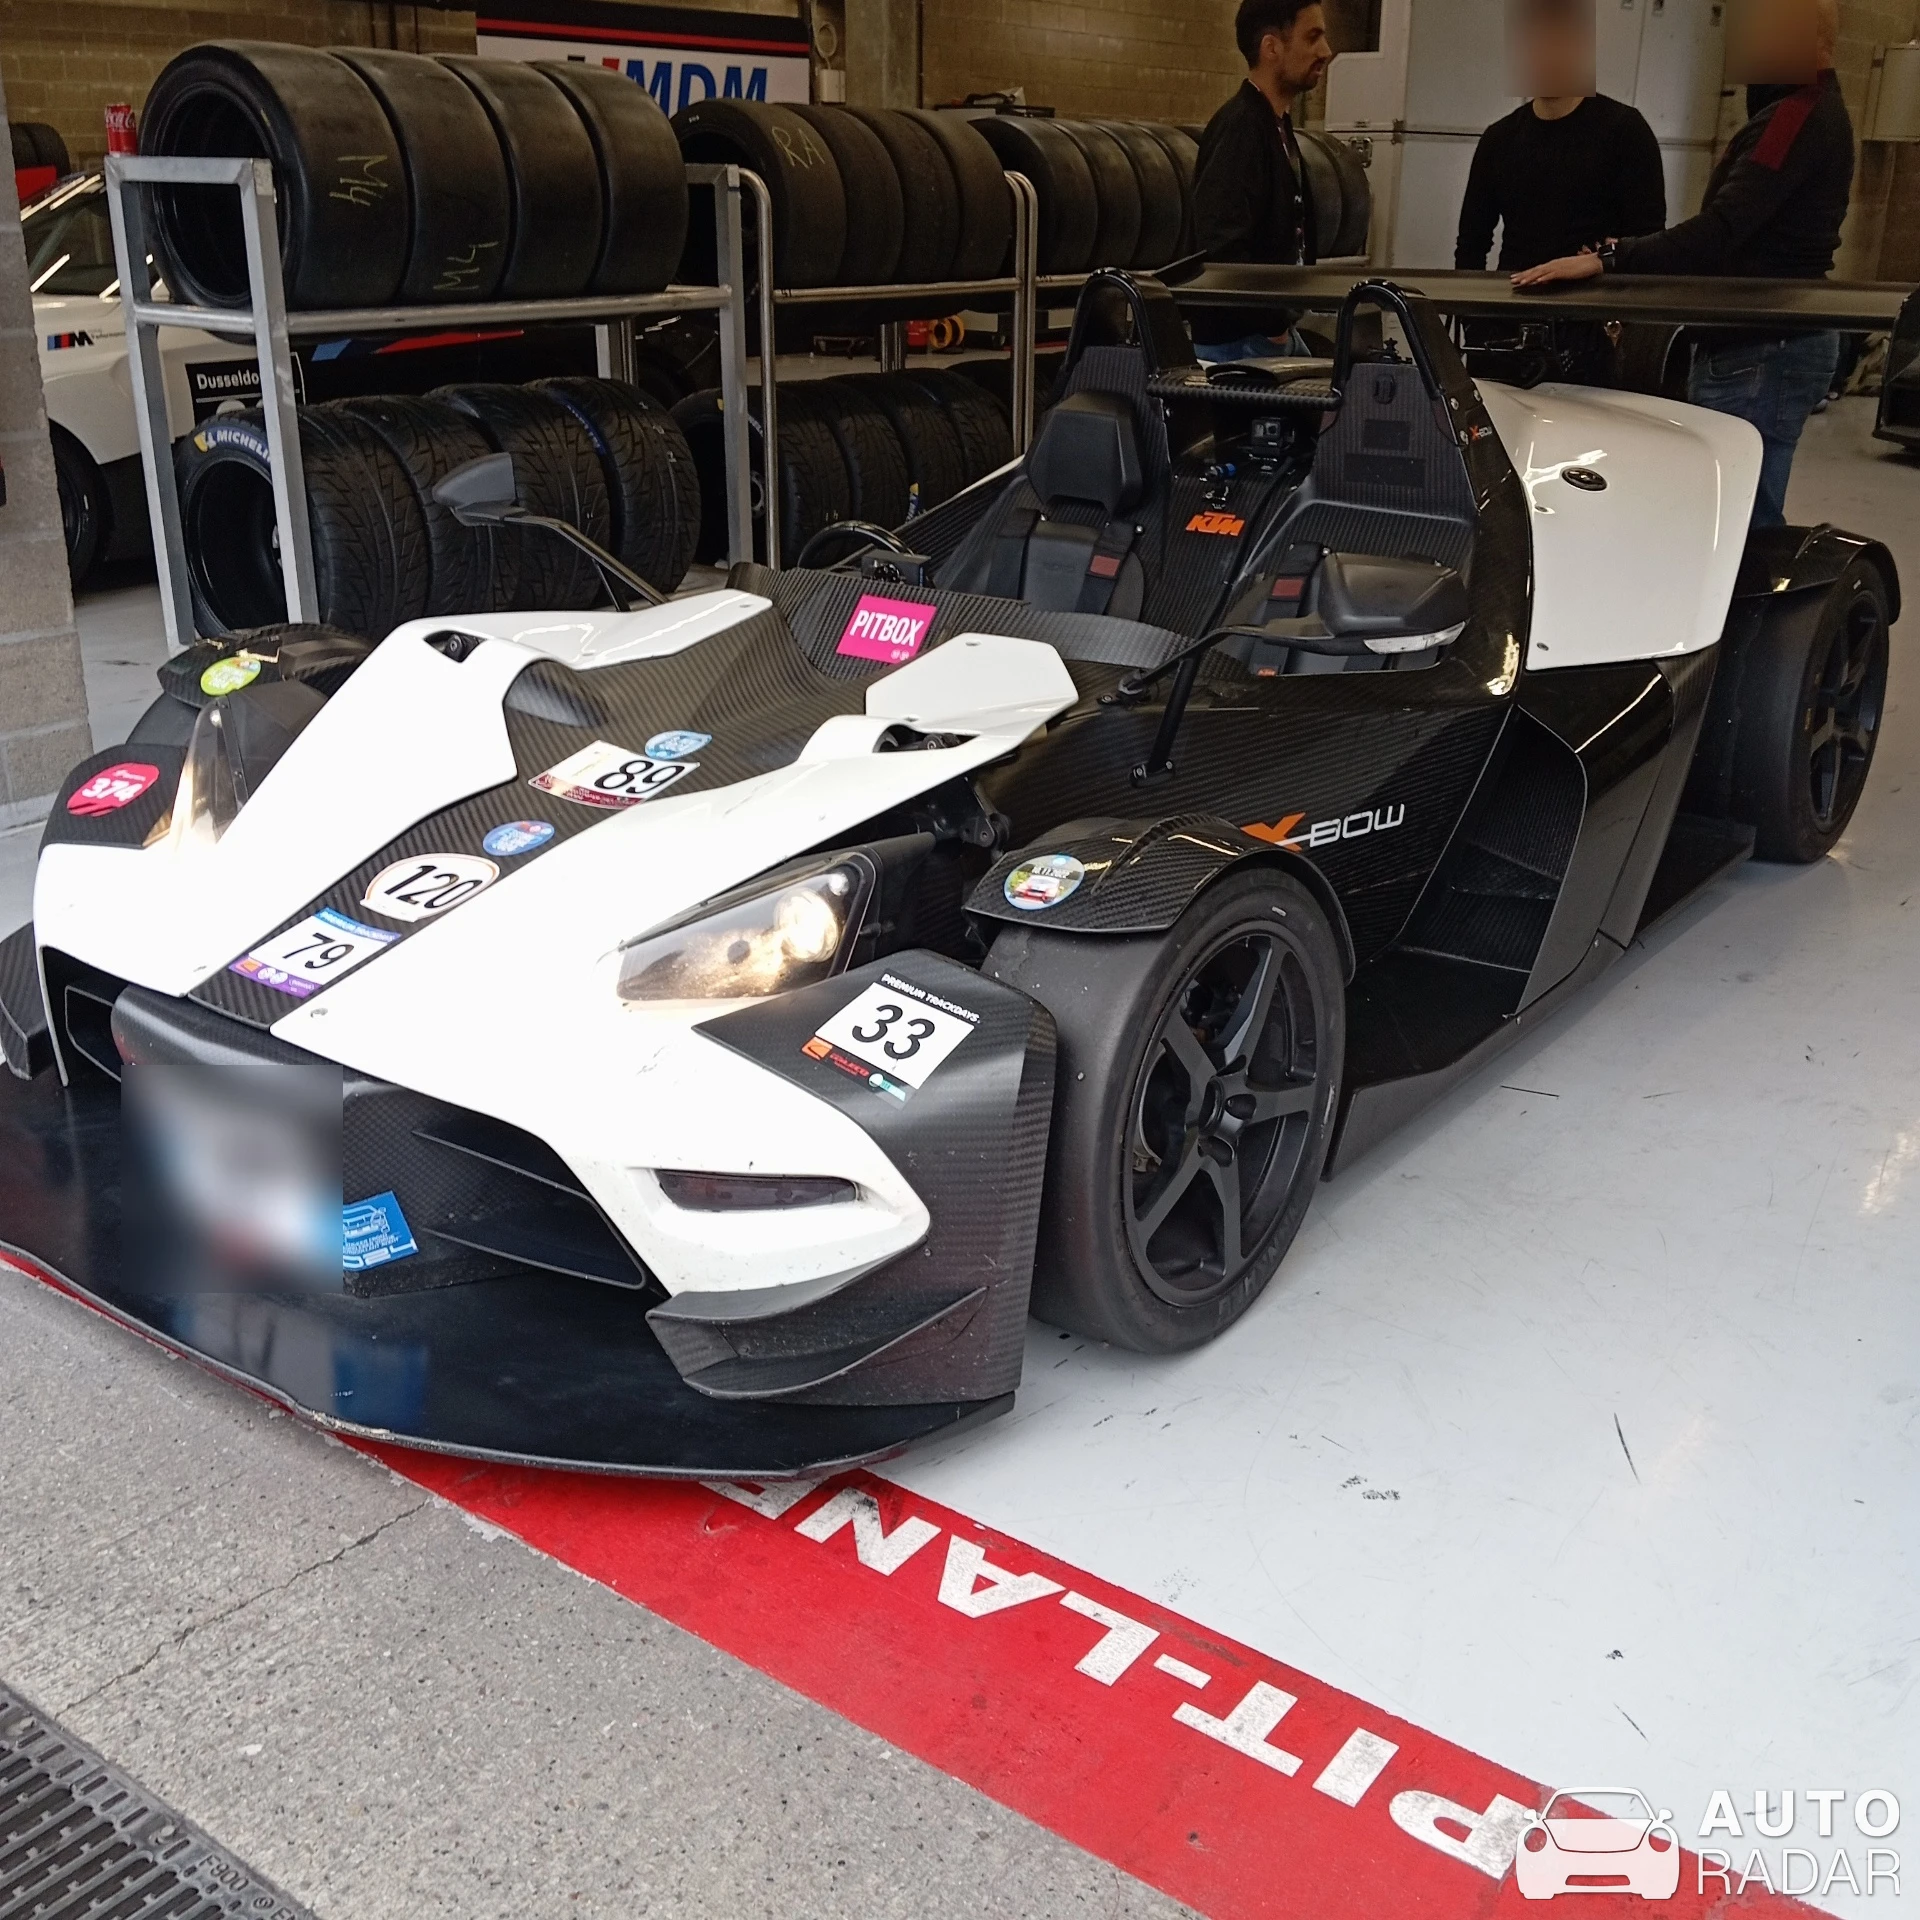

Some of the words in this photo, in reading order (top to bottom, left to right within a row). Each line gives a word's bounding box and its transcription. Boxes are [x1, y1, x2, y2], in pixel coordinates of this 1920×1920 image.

[196, 369, 260, 390] Dusseldo
[216, 429, 271, 463] MICHELI
[1185, 510, 1245, 537] KTM
[849, 609, 925, 648] PITBOX
[594, 760, 686, 794] 89
[1239, 803, 1406, 853] X-BOW
[383, 865, 484, 909] 120
[282, 932, 355, 969] 79
[881, 973, 926, 1000] PREMIUM
[852, 1004, 936, 1060] 33
[198, 1854, 250, 1893] F900
